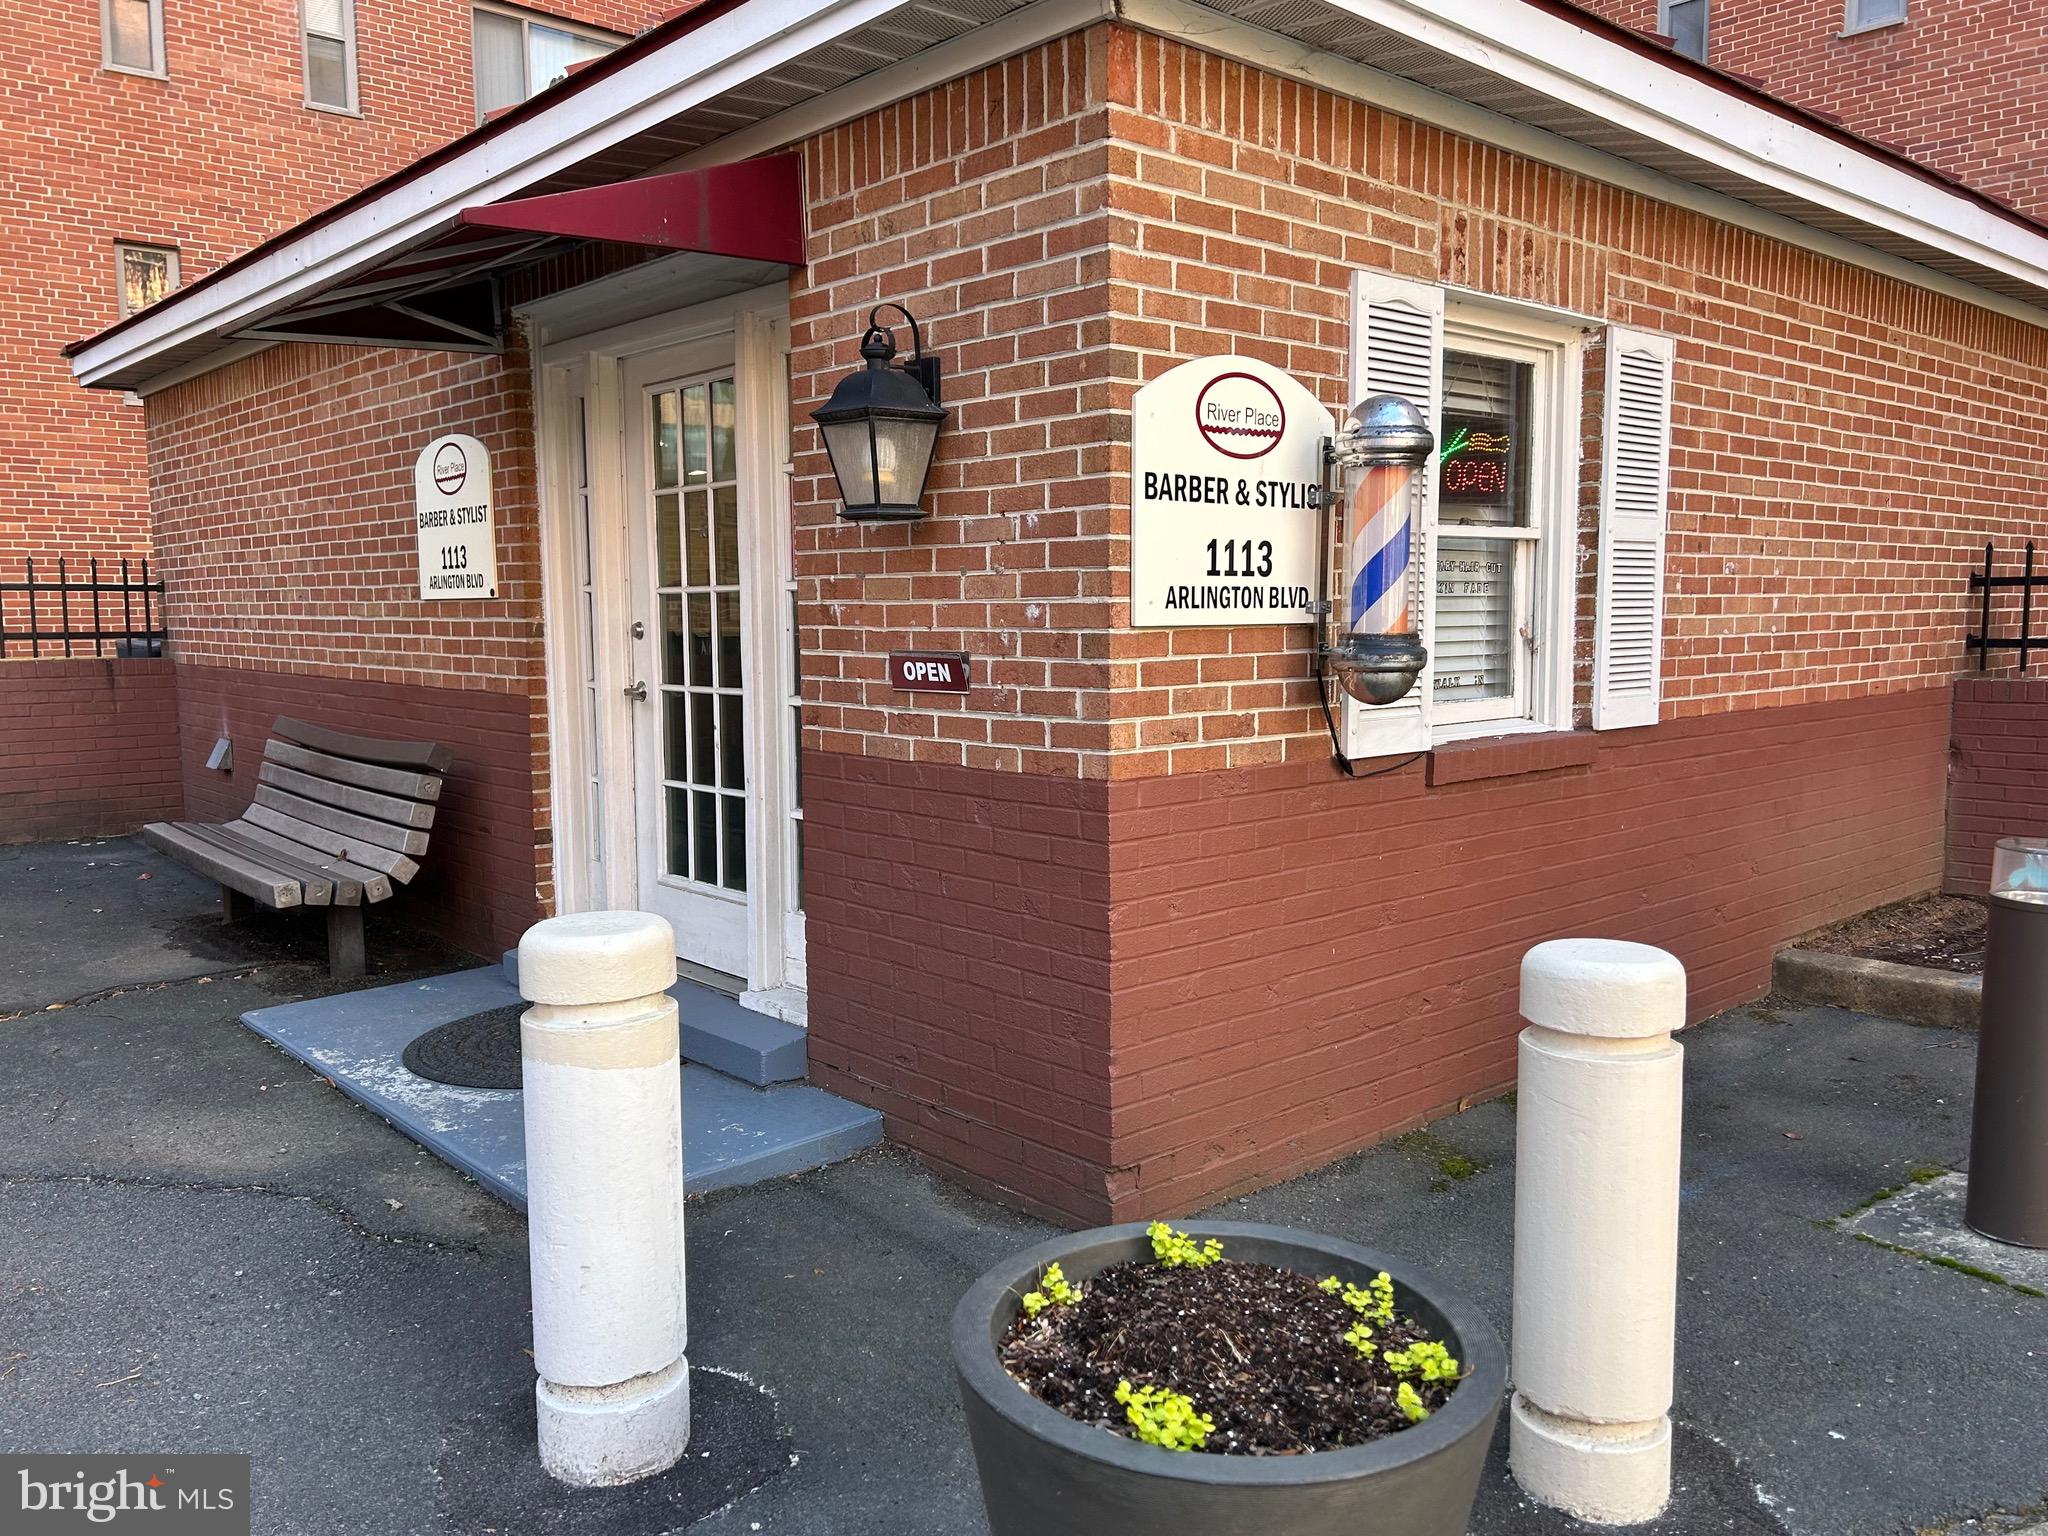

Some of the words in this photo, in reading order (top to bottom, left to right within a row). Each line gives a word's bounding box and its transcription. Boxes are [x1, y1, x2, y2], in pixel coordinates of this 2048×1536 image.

[1207, 402, 1241, 423] River
[1245, 407, 1279, 427] Place
[436, 464, 449, 474] River
[450, 462, 465, 473] Place
[1446, 460, 1507, 493] OPEN
[1144, 472, 1229, 504] BARBER
[1235, 478, 1250, 506] &
[1256, 480, 1322, 510] STYLIS
[419, 511, 449, 528] BARBER
[449, 508, 456, 526] &
[457, 504, 488, 525] STYLIST
[441, 545, 467, 569] 1113
[1206, 538, 1273, 577] 1113
[1486, 562, 1503, 574] CUT
[429, 574, 465, 590] ARLINGTON
[466, 573, 484, 588] BLVD
[1463, 582, 1489, 594] FADE
[1165, 585, 1264, 609] ARLINGTON
[1269, 586, 1309, 609] BLVD
[903, 661, 951, 682] OPEN
